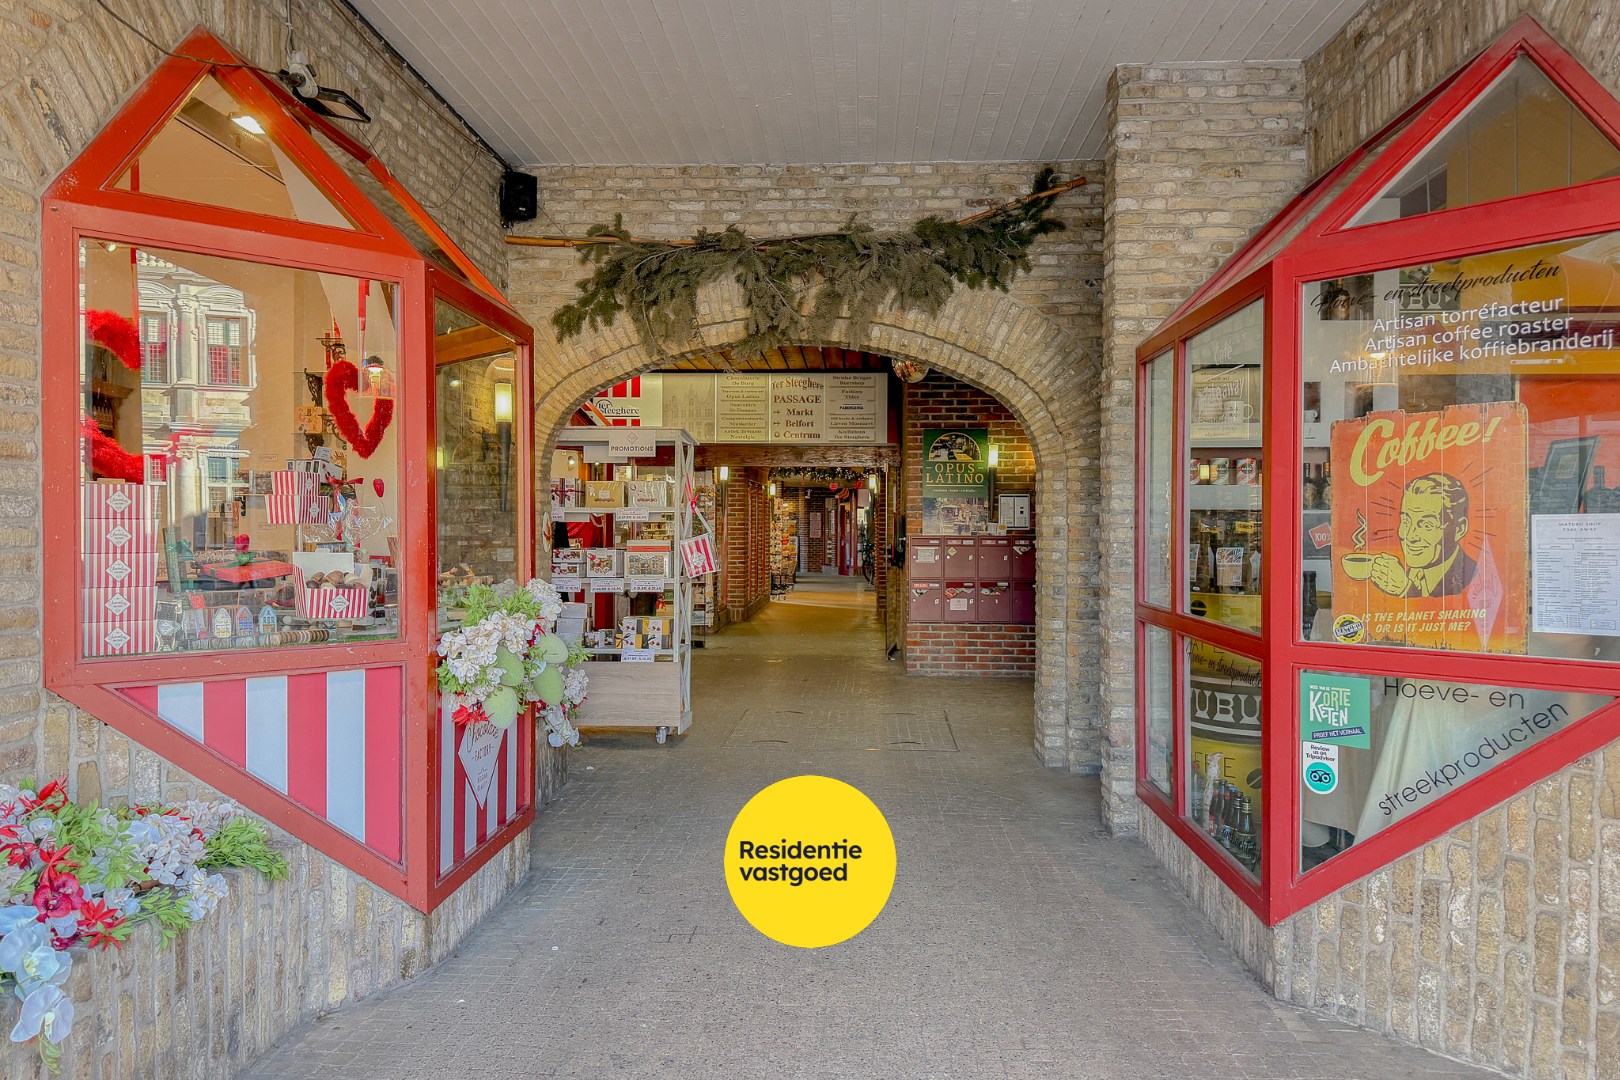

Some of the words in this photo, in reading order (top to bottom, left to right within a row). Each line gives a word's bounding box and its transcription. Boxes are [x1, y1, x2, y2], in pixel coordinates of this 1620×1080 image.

[1384, 288, 1404, 302] en
[1408, 259, 1561, 301] streekproducten
[1372, 314, 1435, 333] Artisan
[1441, 296, 1564, 325] torréfacteur
[1365, 333, 1427, 352] Artisan
[1432, 323, 1493, 344] coffee
[1499, 314, 1574, 337] roaster
[1329, 349, 1453, 375] Ambachtelijke
[1460, 329, 1614, 361] koffiebranderij
[772, 381, 783, 390] Ter
[786, 377, 824, 391] Steeghere
[773, 395, 821, 404] PASSAGE
[786, 408, 813, 416] Markt
[785, 420, 814, 428] Belfort
[783, 431, 821, 439] Centrum
[1349, 416, 1501, 486] Coffee!
[934, 463, 976, 474] OPUS
[925, 473, 984, 483] LATINO
[1362, 613, 1374, 622] IS
[1375, 611, 1395, 622] THE
[1396, 610, 1435, 621] PLANET
[1437, 608, 1487, 620] SHAKING
[1375, 622, 1391, 633] OR
[1393, 622, 1404, 632] IS
[1406, 622, 1418, 632] IT
[1419, 621, 1446, 632] JUST
[1448, 621, 1471, 632] ME?
[1384, 677, 1479, 703] Hoeve-
[1489, 691, 1524, 709] en
[1378, 703, 1569, 816] streekproducten
